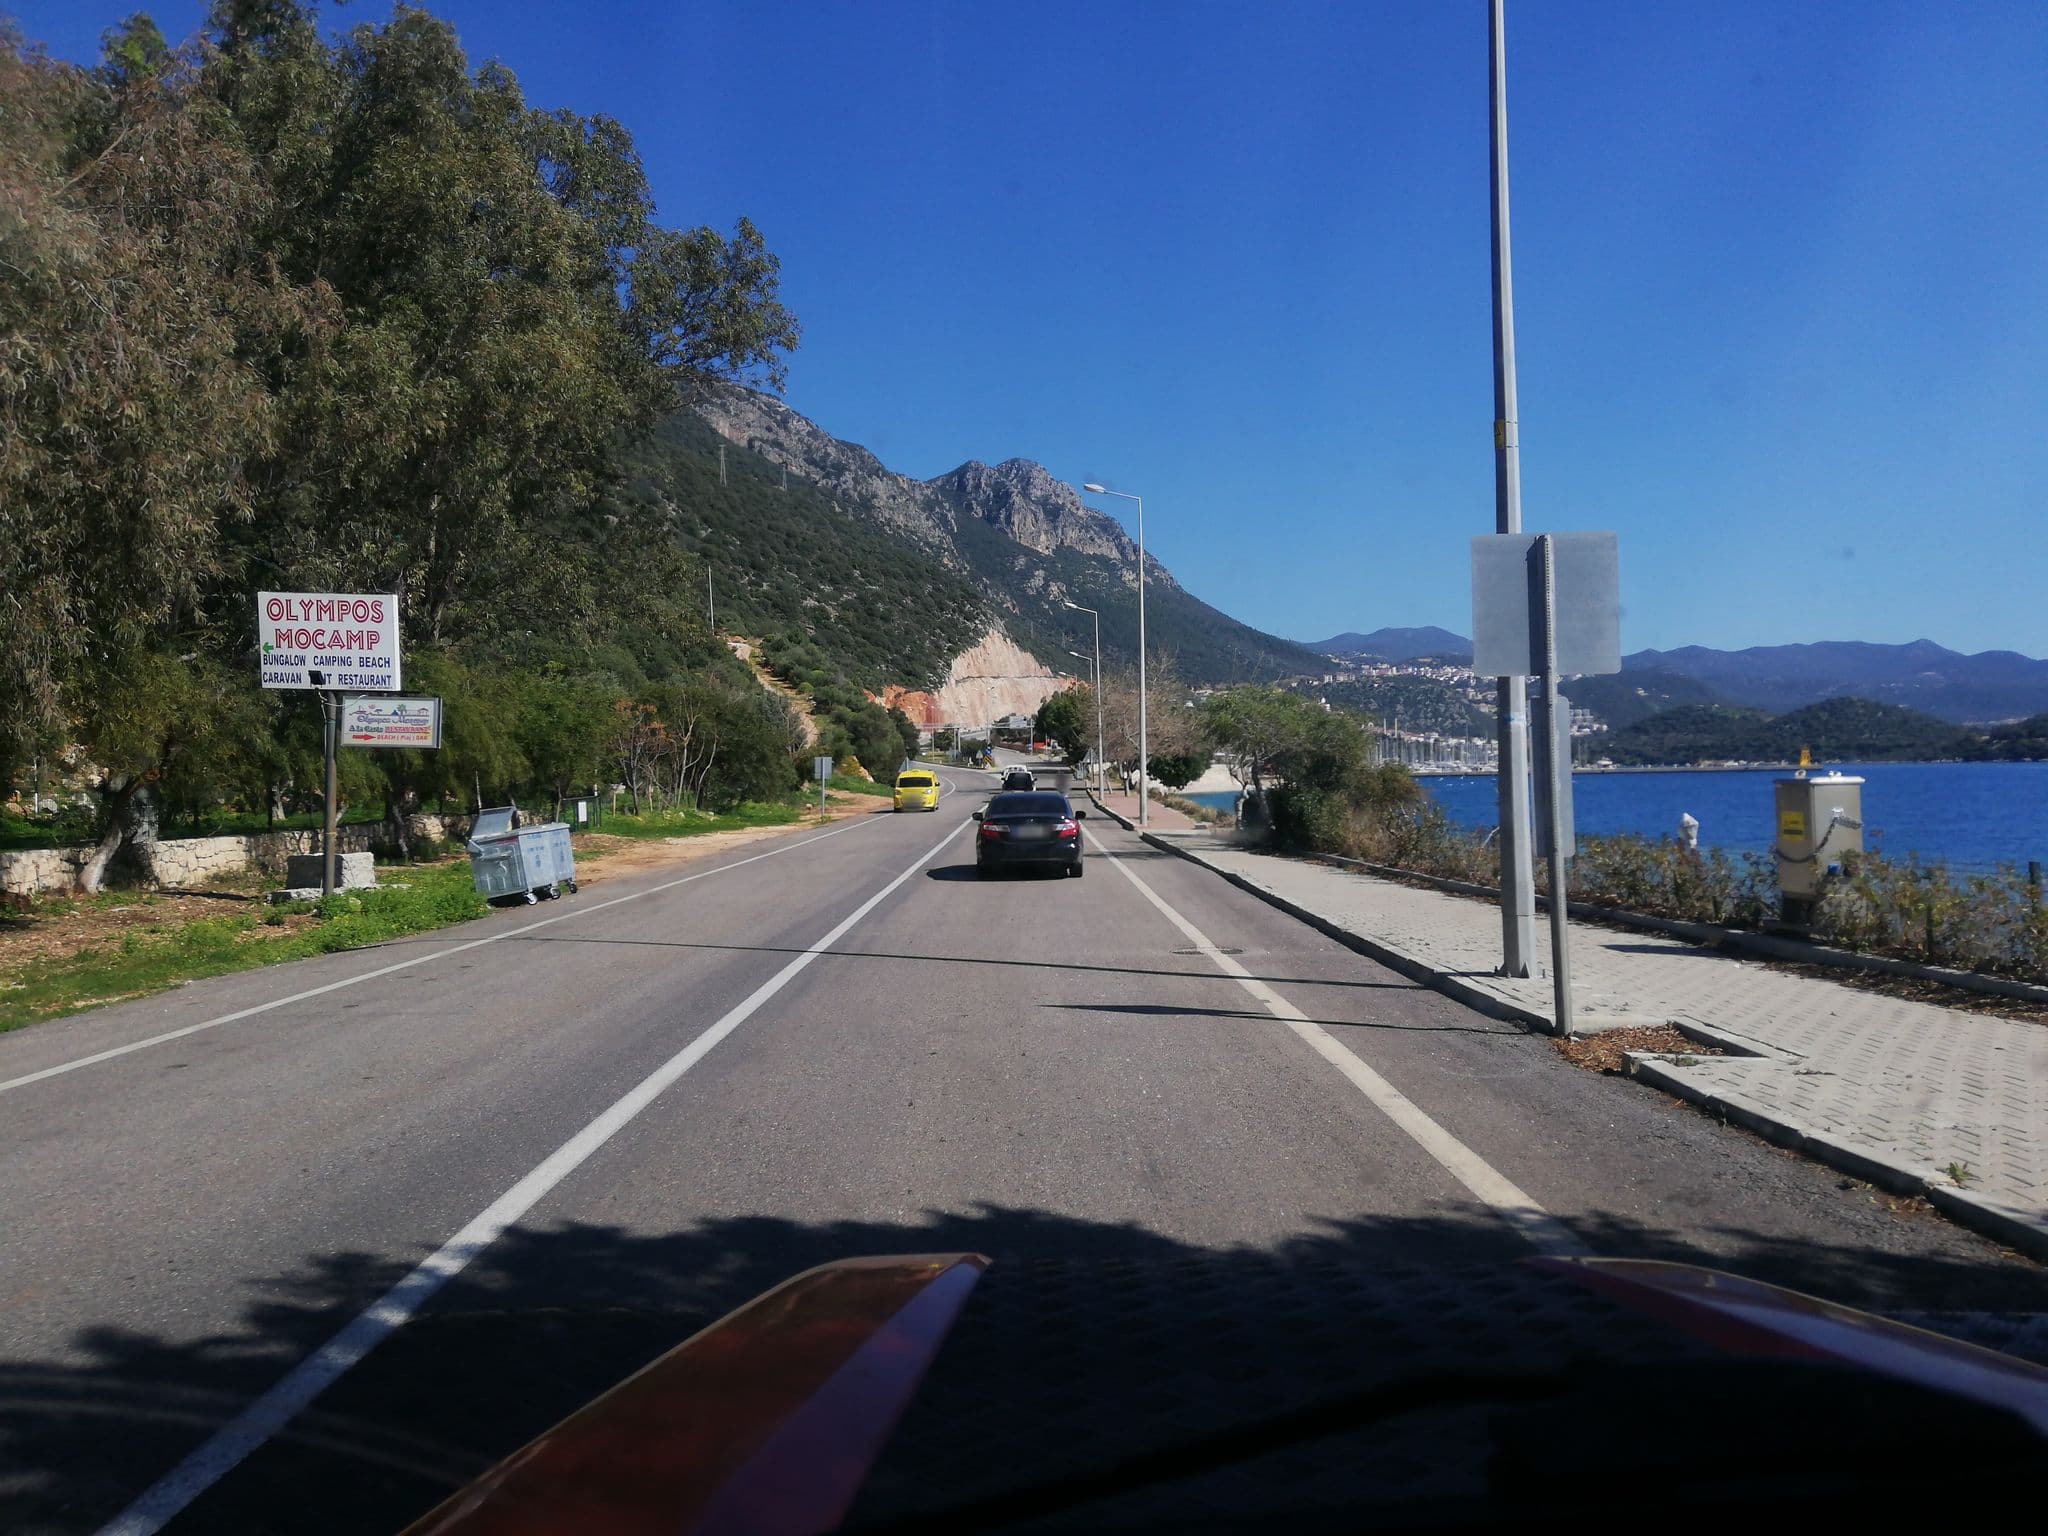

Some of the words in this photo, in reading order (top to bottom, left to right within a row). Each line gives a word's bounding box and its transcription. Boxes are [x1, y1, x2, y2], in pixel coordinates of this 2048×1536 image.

[266, 597, 384, 623] OLYMPOS
[275, 628, 380, 650] MOCAMP
[263, 654, 306, 666] BUNGALOW
[313, 655, 352, 667] CAMPING
[359, 657, 391, 668] BEACH
[263, 672, 302, 684] CARAVAN
[338, 673, 392, 686] RESTAURANT
